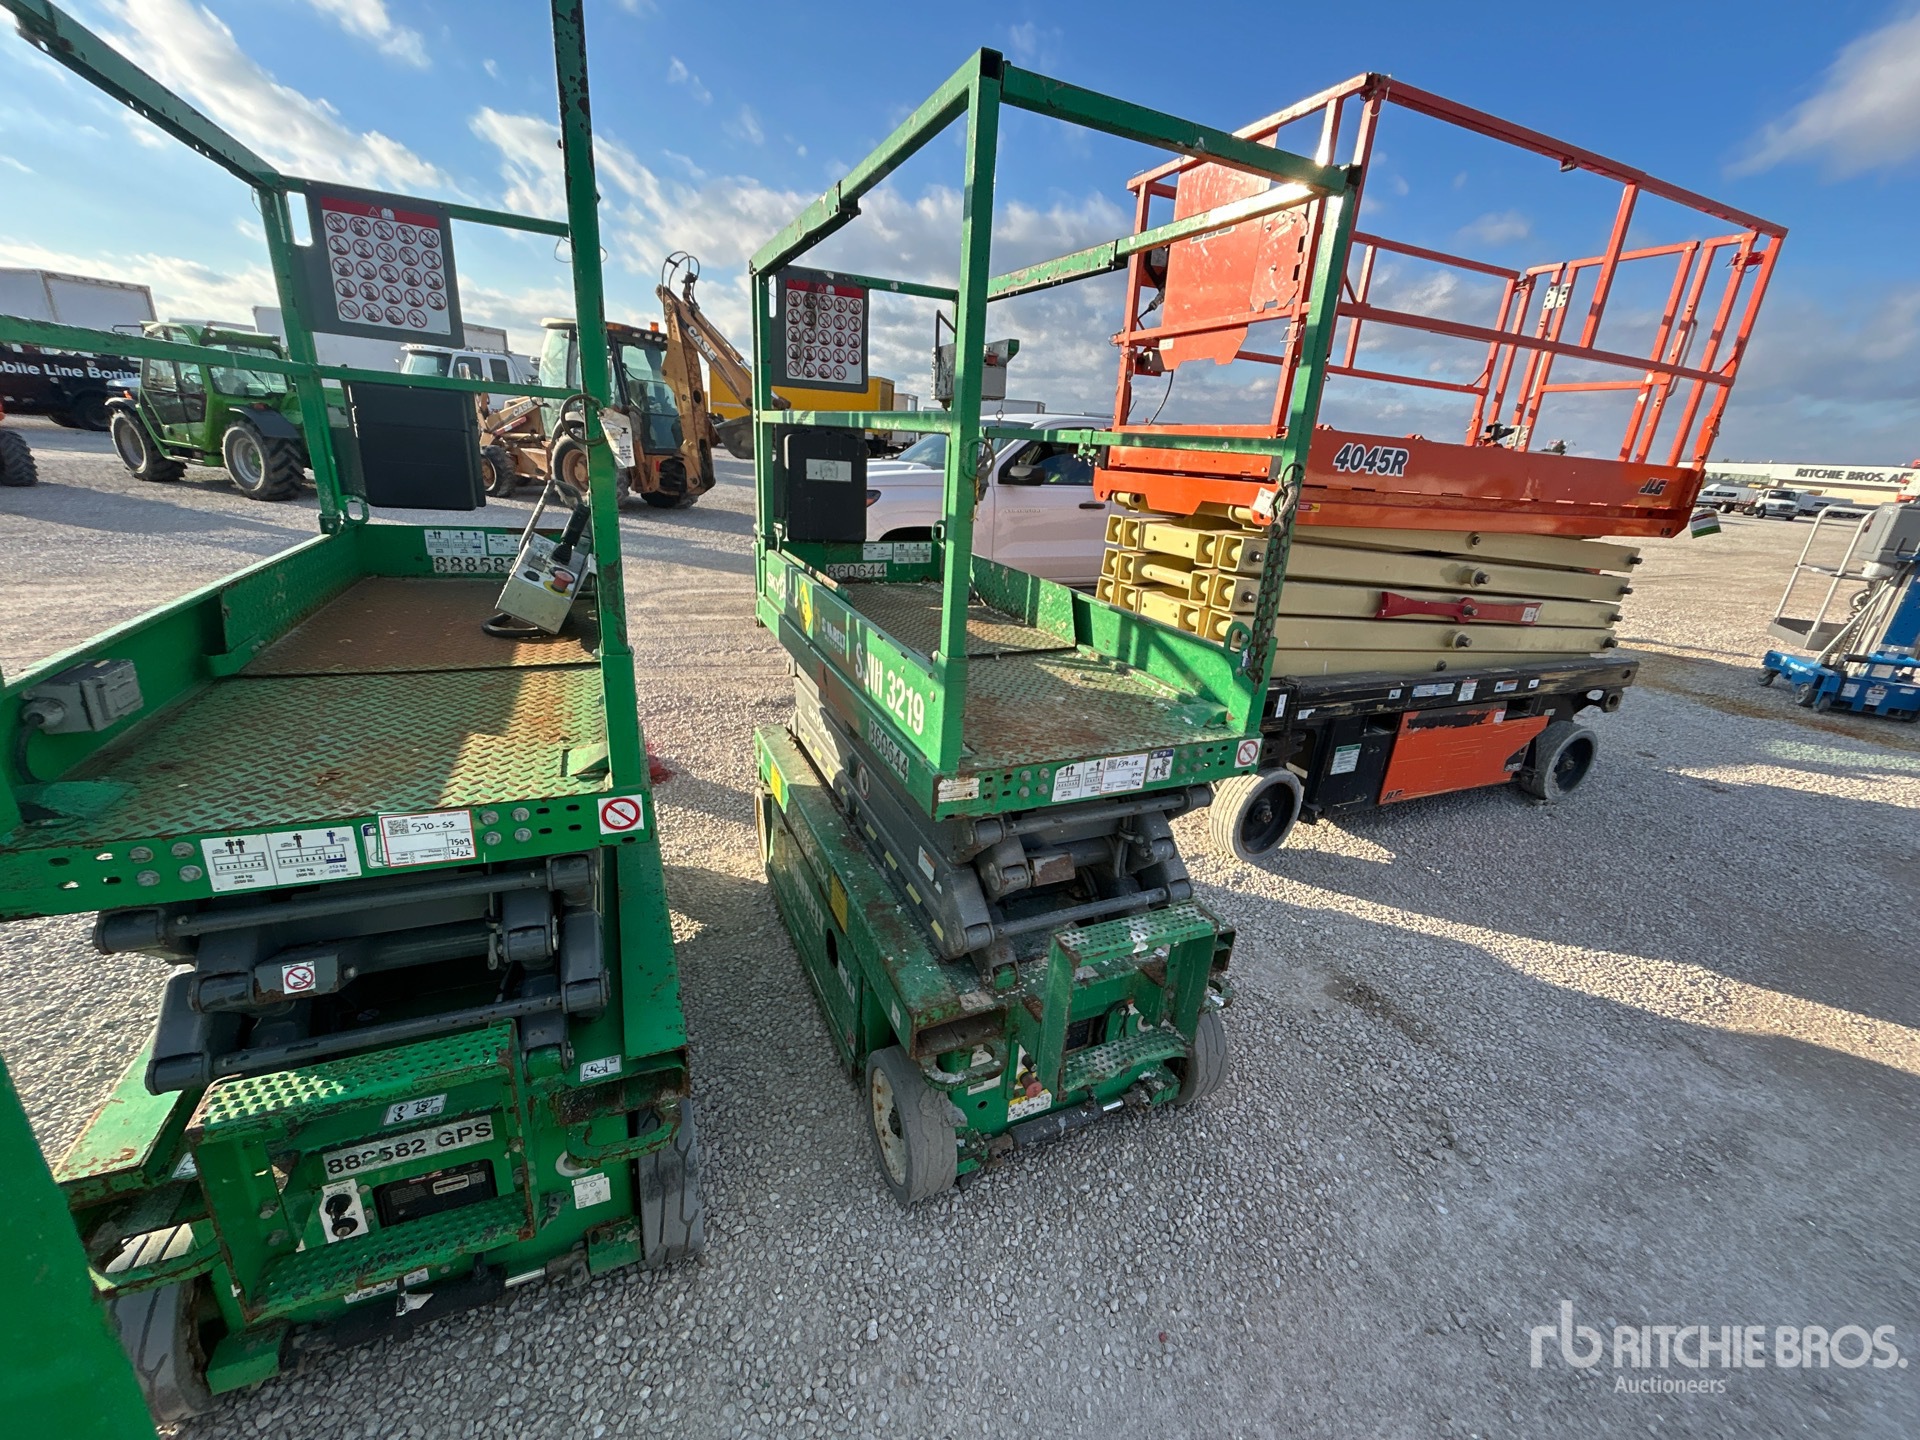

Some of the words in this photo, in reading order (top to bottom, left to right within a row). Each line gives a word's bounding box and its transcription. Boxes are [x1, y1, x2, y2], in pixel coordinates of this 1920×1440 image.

[0, 361, 40, 374] bile
[43, 363, 83, 377] Line
[1333, 443, 1409, 477] 4045R
[1795, 468, 1845, 480] RITCHIE
[1846, 471, 1885, 483] BROS.
[1638, 477, 1669, 495] JLG
[827, 563, 886, 578] 860644
[887, 669, 925, 735] 3219
[435, 1122, 492, 1148] GPS
